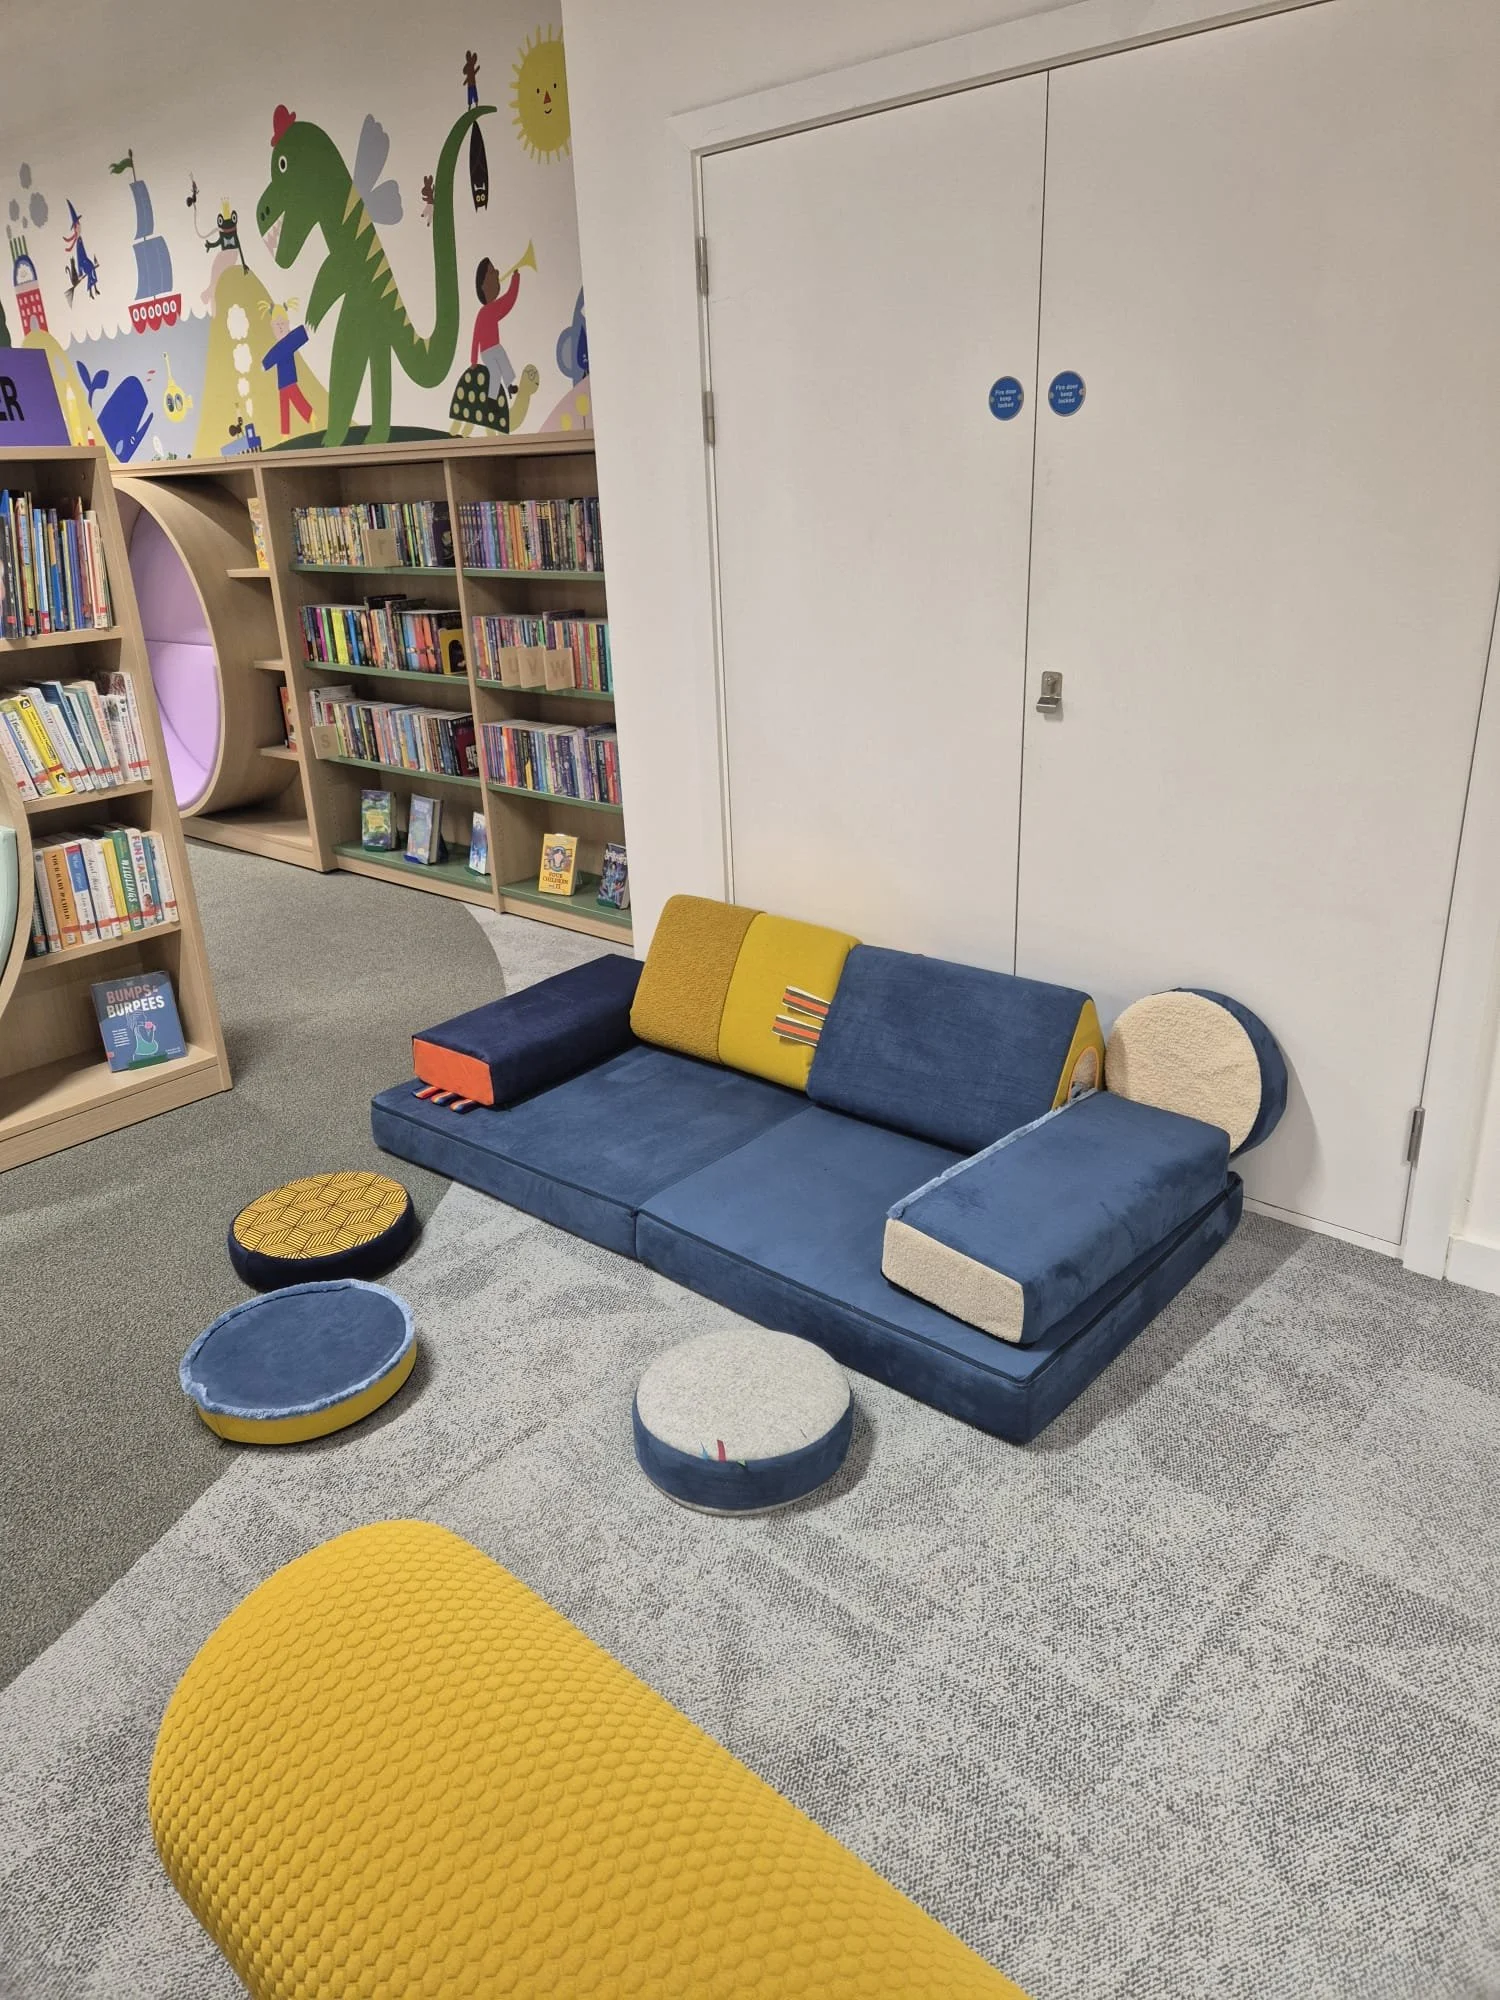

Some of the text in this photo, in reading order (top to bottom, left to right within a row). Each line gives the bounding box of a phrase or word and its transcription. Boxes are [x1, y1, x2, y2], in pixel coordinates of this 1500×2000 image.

[0, 376, 24, 421] R
[106, 984, 151, 1004] BUMPS
[107, 995, 165, 1018] BURPEES
